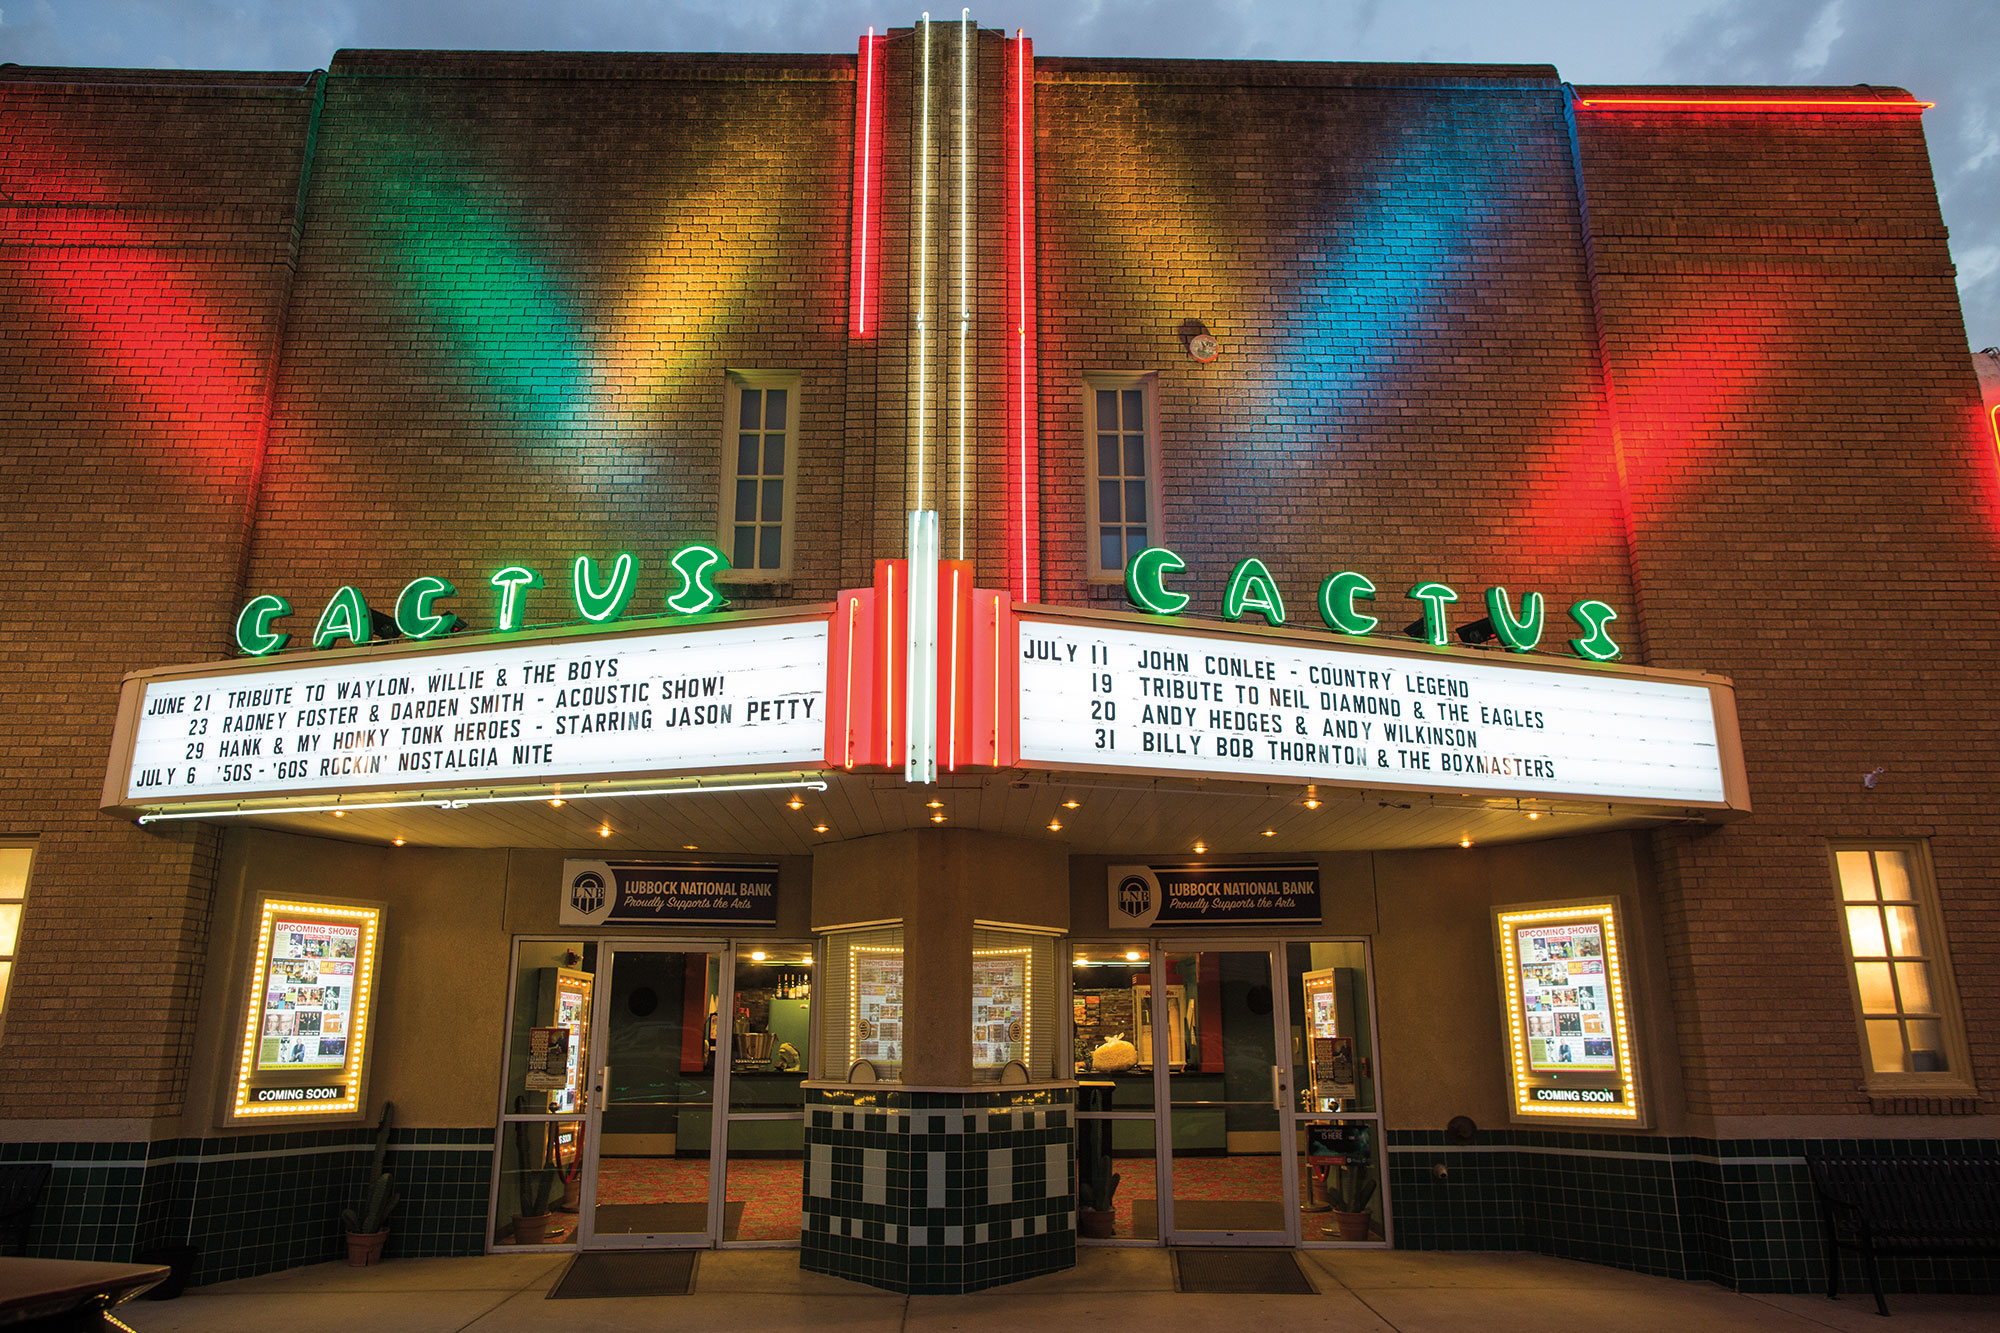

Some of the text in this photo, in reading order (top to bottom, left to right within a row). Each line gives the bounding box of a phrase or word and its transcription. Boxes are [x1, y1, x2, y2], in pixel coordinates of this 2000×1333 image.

[236, 546, 730, 657] CACTUS
[1125, 547, 1620, 661] CACTUS
[1024, 640, 1077, 662] JULY
[1092, 645, 1107, 665] 11
[1138, 650, 1188, 672] JOHN
[1206, 656, 1275, 680] CONLEE
[1310, 666, 1390, 690] COUNTRY
[1406, 675, 1468, 698] LEGEND
[149, 659, 618, 715] JUNE 21 TRIBUTE TO WAYLON, WILLIE & THE BOYS
[1093, 673, 1543, 728] 19 TRIBUTE TO NEIL DIAMOND & THE EAGLES
[189, 719, 208, 735] 23
[223, 712, 287, 733] RADNEY
[297, 706, 358, 727] FOSTER
[369, 705, 379, 722] &
[391, 698, 458, 720] DARDEN
[470, 693, 523, 714] SMITH
[556, 683, 649, 708] ACOUSTIC
[663, 676, 724, 699] SHOW!
[186, 743, 204, 759] 29
[219, 738, 261, 757] HANK
[274, 738, 283, 754] &
[298, 735, 320, 752] MY
[333, 729, 389, 750] HONKY
[402, 725, 443, 745] TONK
[454, 719, 520, 741] HEROES
[556, 710, 652, 734] STARRING
[666, 704, 732, 727] JASON
[747, 698, 814, 721] PETTY
[1091, 700, 1476, 748] 20 ANDY HEDGES & ANDY WILKINSON
[137, 768, 176, 787] JULY
[187, 767, 195, 784] 6
[320, 755, 387, 776] ROCKIN'
[399, 748, 497, 771] NOSTALGIA
[513, 744, 552, 764] NITE
[1095, 729, 1554, 778] 31 BILLY BOB THORNTON & THE BOXMASTERS
[573, 887, 604, 899] LNB
[625, 881, 772, 896] LUBBOCK NATIONAL BANK
[1120, 891, 1150, 901] LNB
[1169, 881, 1315, 896] LUBBOCK NATIONAL BANK
[624, 896, 752, 912] Proudly Supports the Arts
[1170, 896, 1296, 914] Proudly Supports the Arts
[277, 923, 358, 937] UPCOMING SHOWS
[1519, 925, 1599, 939] UPCOMING SHOWS
[258, 1088, 337, 1101] COMING SOON
[1537, 1090, 1614, 1102] COMING SOON
